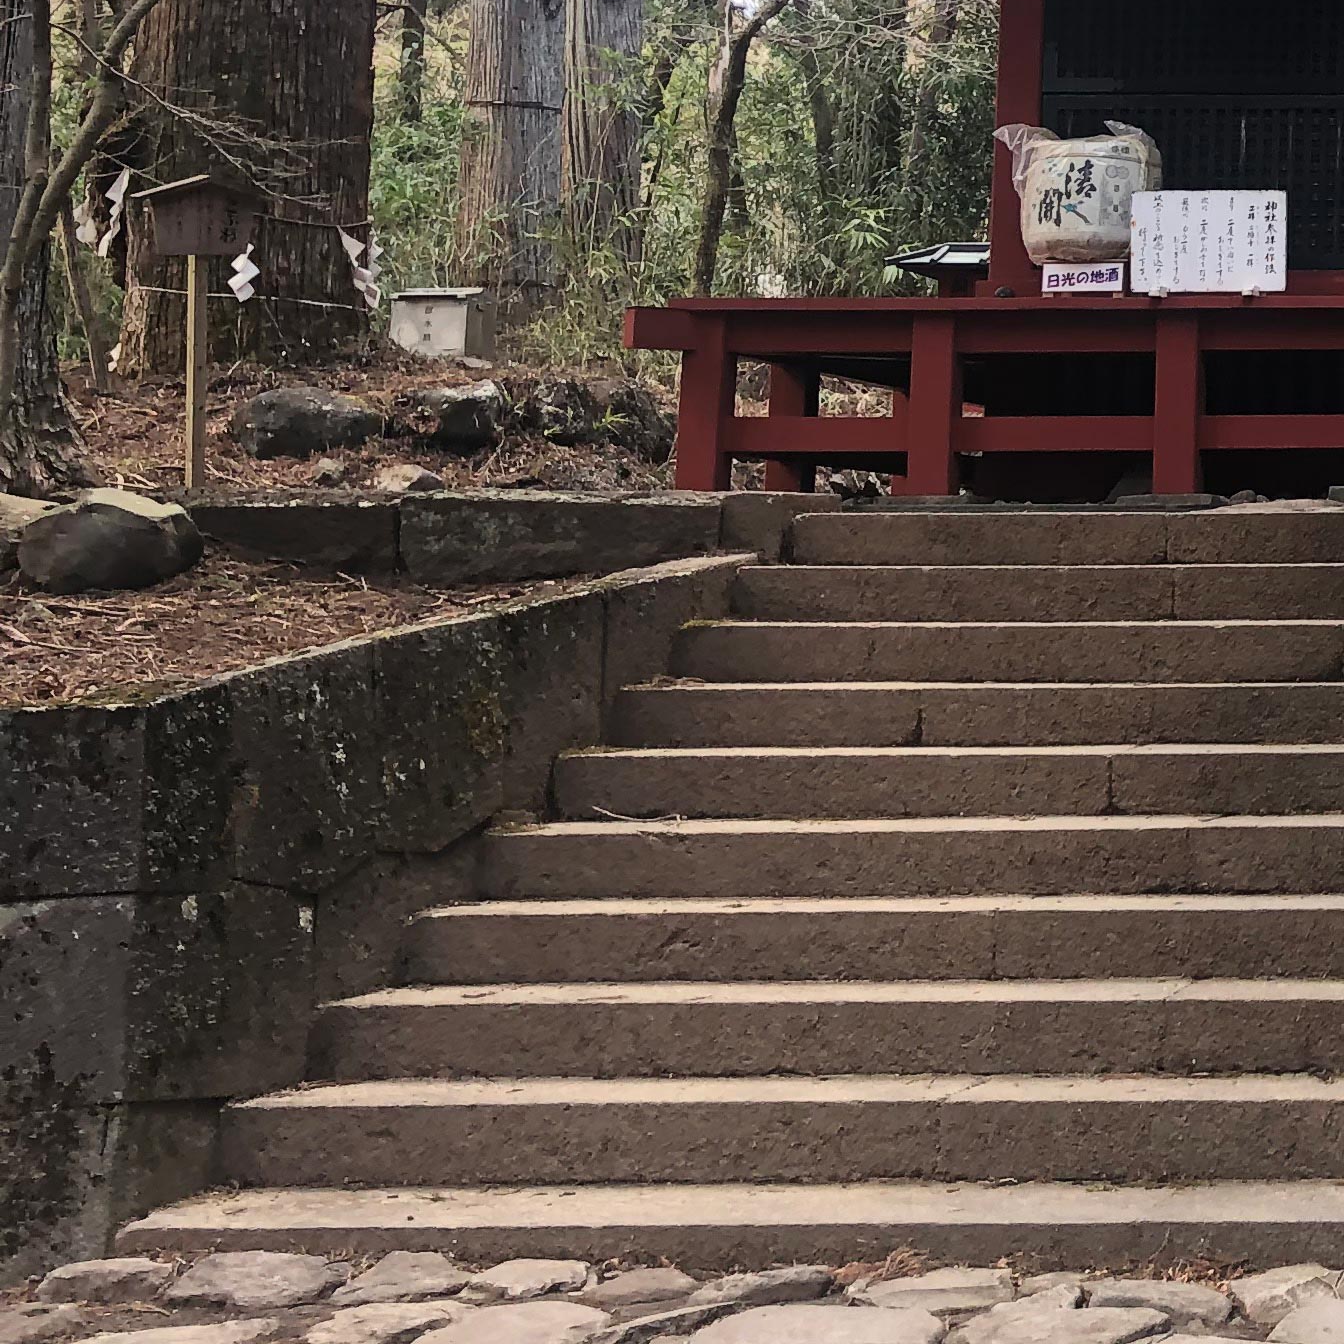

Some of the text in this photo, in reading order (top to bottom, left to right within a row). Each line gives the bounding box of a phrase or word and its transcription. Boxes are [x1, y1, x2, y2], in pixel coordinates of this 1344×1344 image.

[1047, 267, 1119, 289] 日光の地酒
